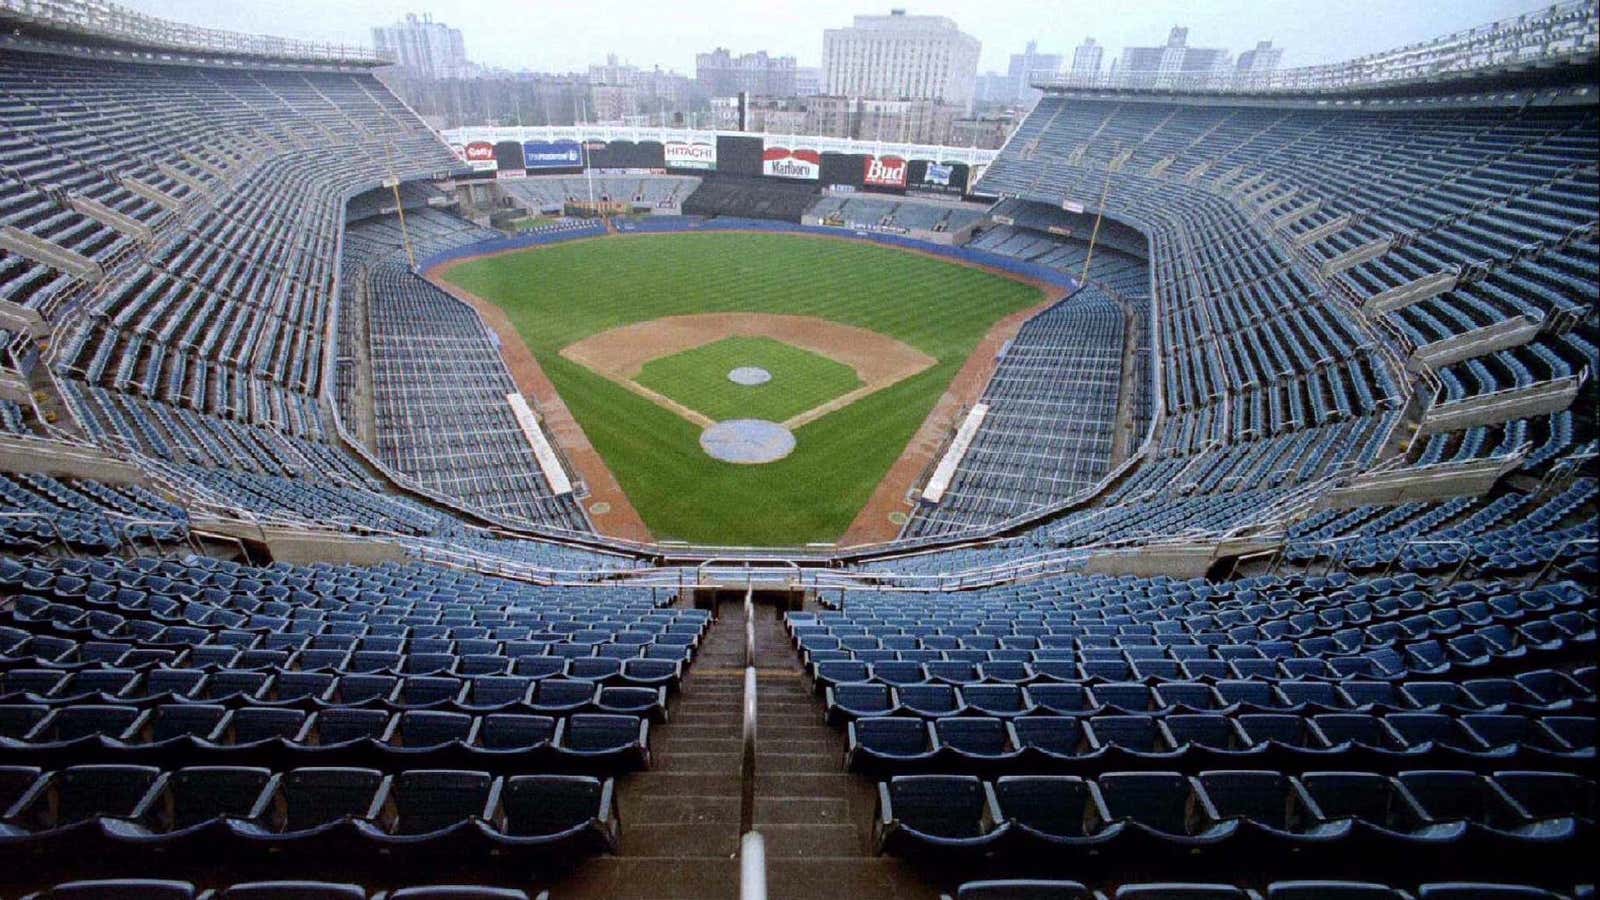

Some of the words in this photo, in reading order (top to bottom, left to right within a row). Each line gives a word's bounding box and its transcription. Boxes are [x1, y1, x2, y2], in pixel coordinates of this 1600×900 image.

[667, 147, 712, 159] HITACHI
[771, 160, 810, 176] Marlboro
[867, 160, 906, 181] Bud
